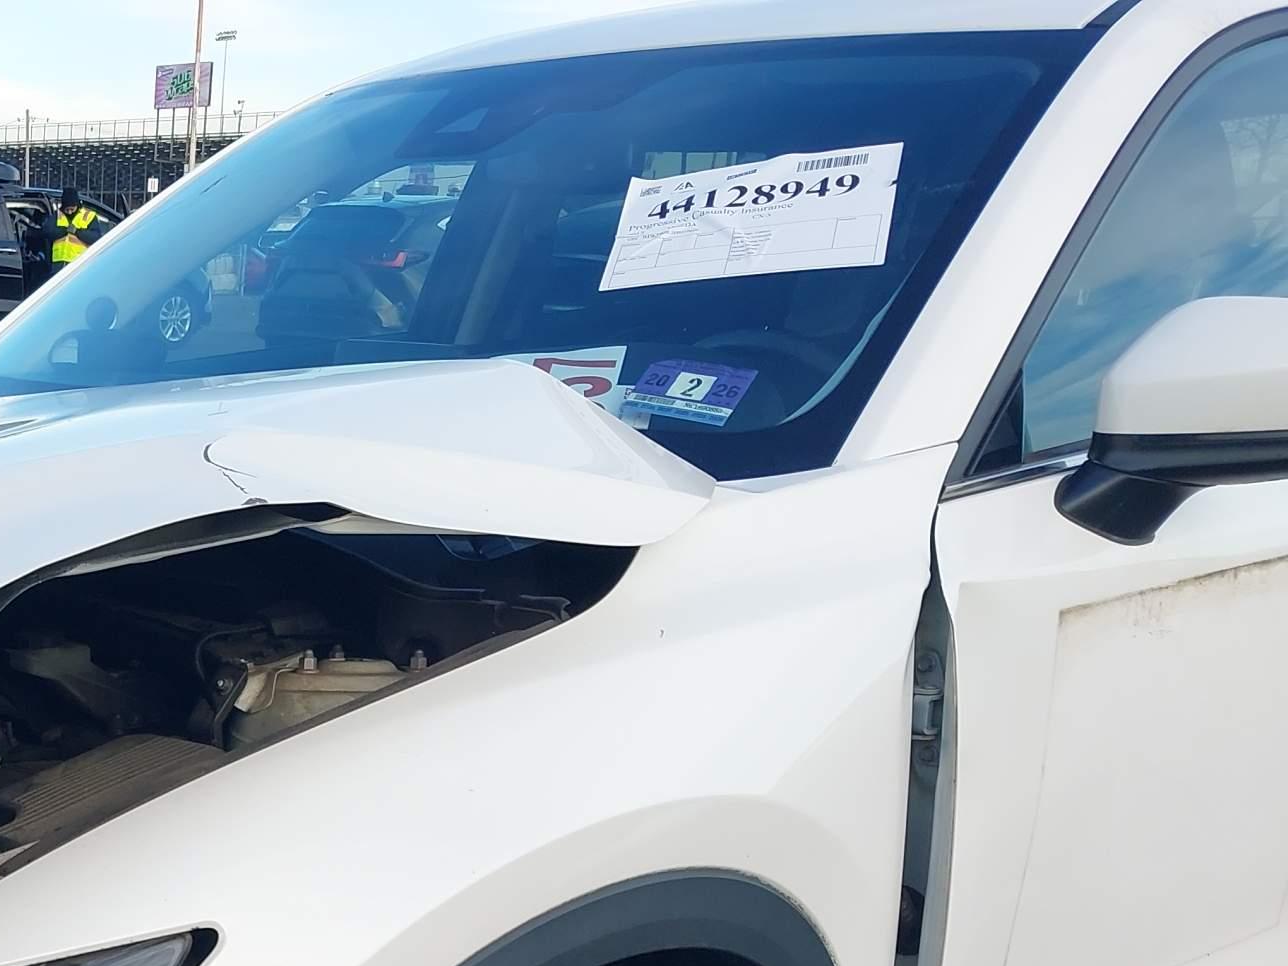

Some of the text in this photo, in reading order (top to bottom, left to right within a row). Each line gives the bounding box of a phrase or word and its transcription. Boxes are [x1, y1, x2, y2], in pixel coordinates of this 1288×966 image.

[647, 174, 860, 219] 44128949
[628, 202, 795, 232] Progressive Casualty Insurance
[644, 372, 741, 399] 20 2 26
